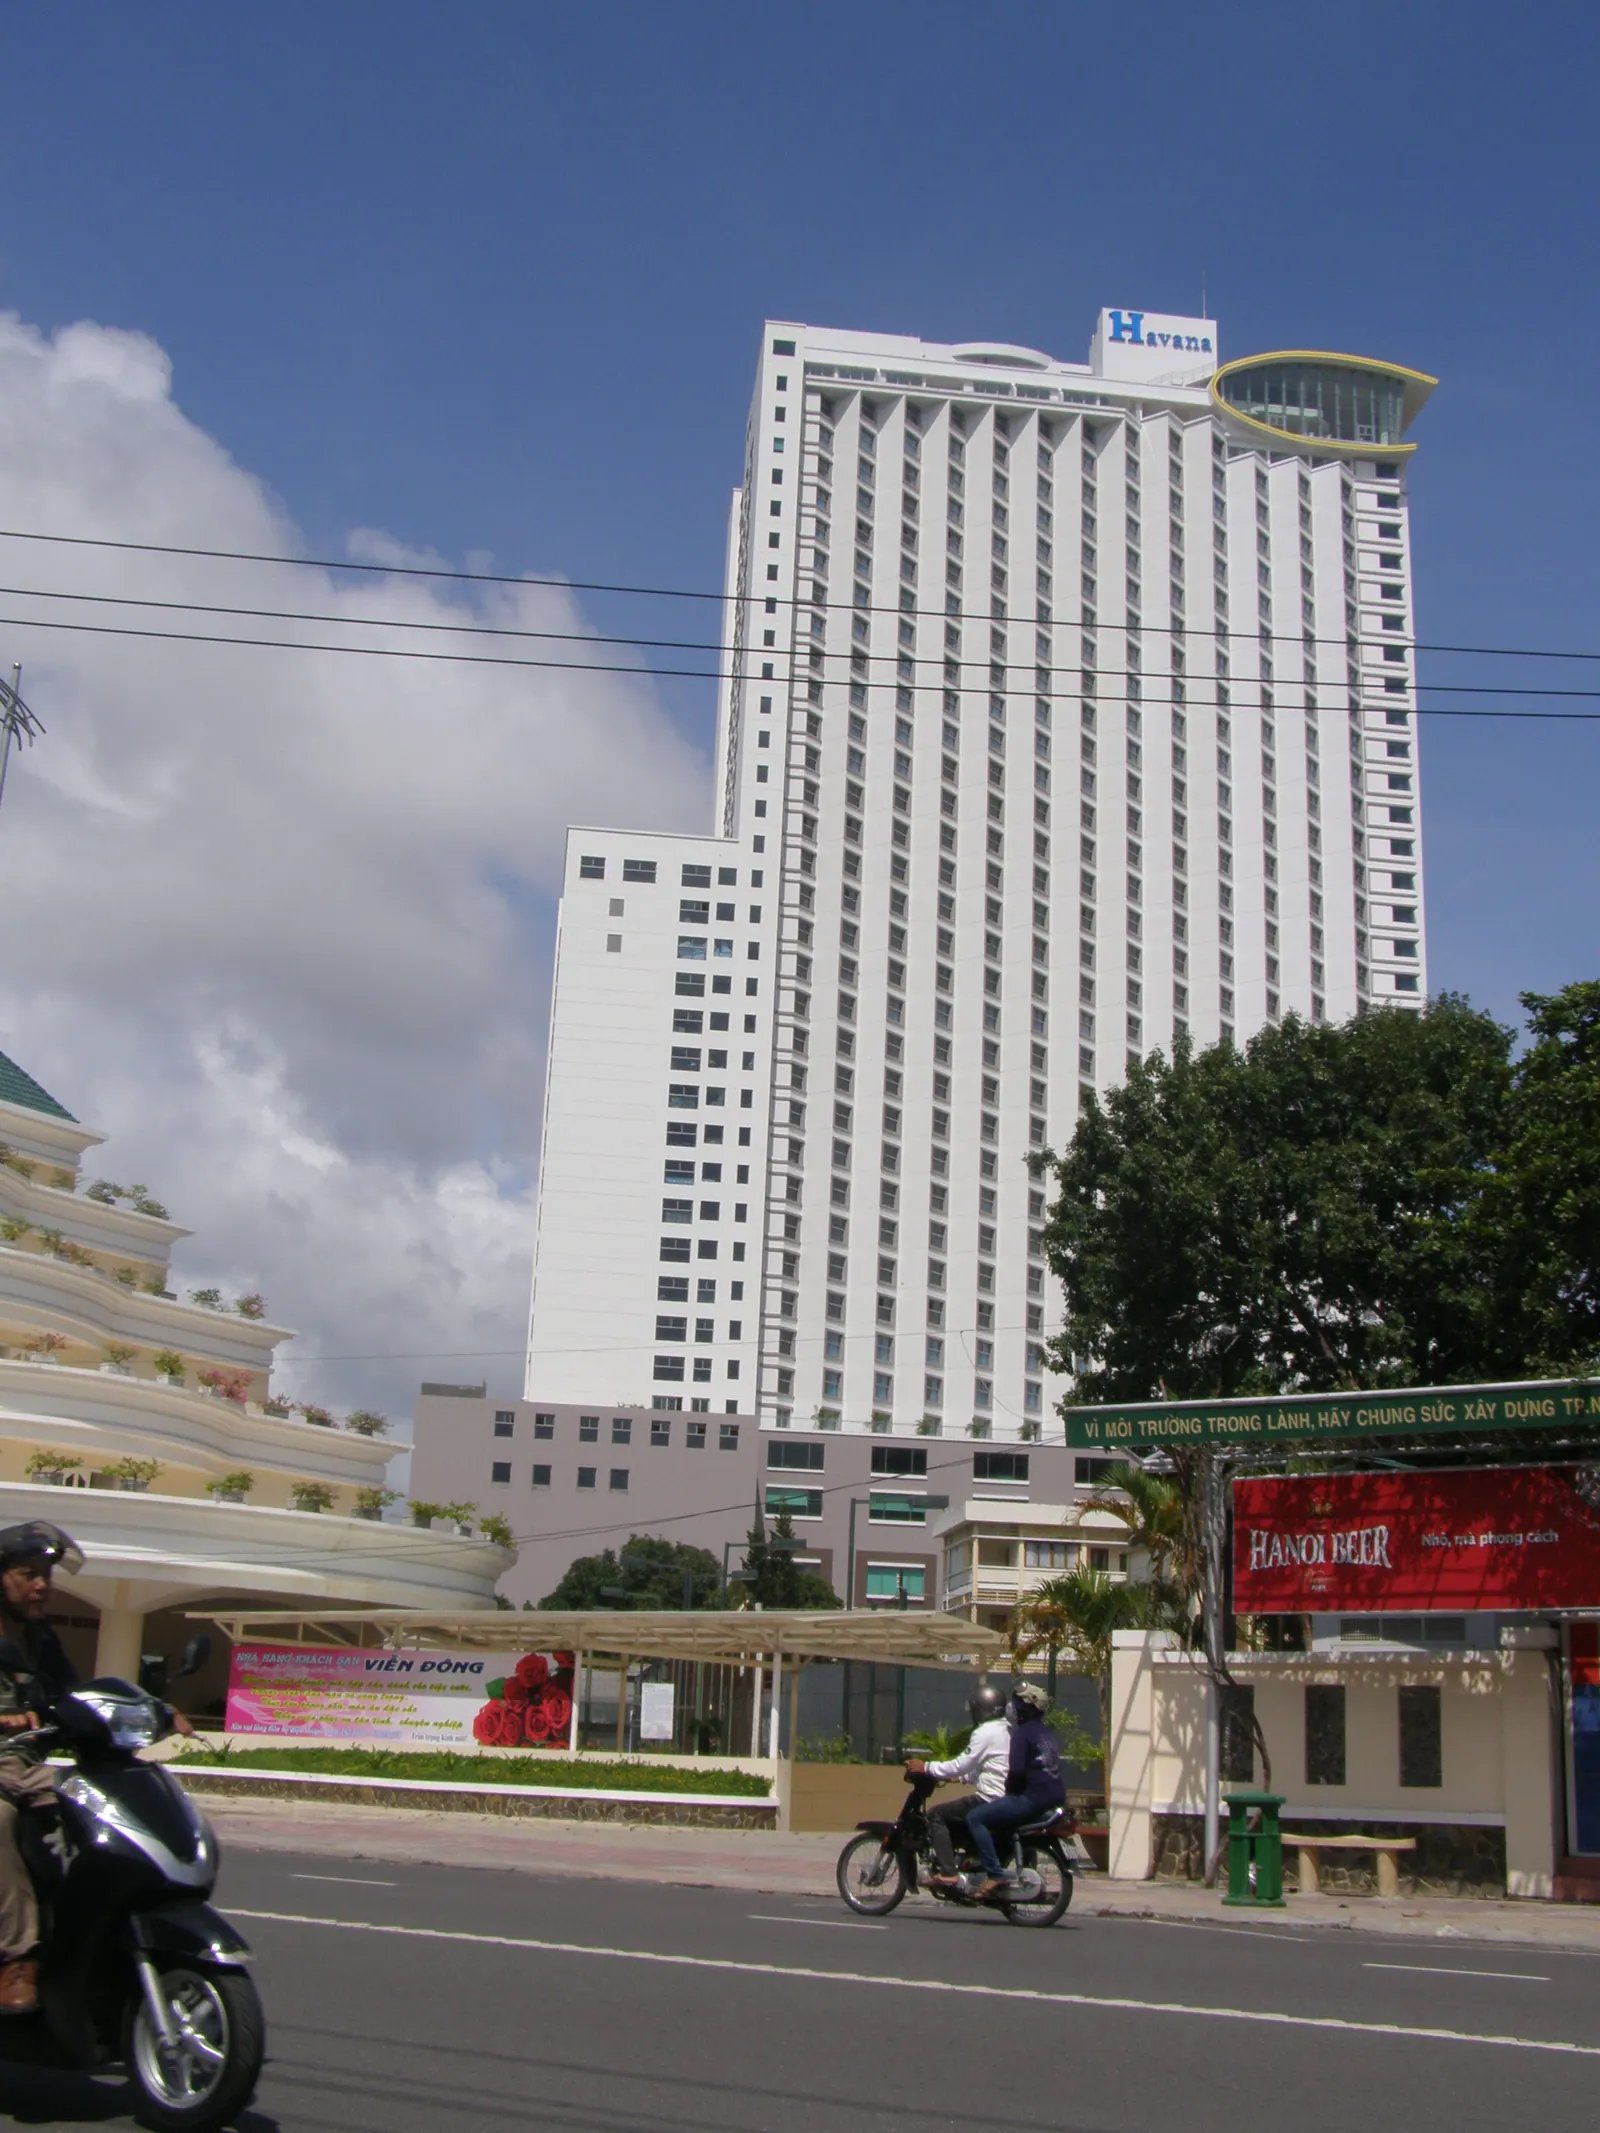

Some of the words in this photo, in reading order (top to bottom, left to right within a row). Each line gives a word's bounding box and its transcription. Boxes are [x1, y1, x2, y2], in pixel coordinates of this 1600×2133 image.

[1108, 310, 1213, 354] Havana
[1085, 1418, 1099, 1438] VÌ
[1105, 1417, 1133, 1438] MÔI
[1137, 1414, 1202, 1436] TRƯỜNG
[1207, 1414, 1262, 1433] TRONG
[1267, 1409, 1315, 1431] LÀNH,
[1318, 1407, 1351, 1428] HÃY
[1356, 1407, 1416, 1426] CHUNG
[1421, 1400, 1456, 1422] SỨC
[1464, 1399, 1497, 1420] XÂY
[1504, 1398, 1556, 1422] DỰNG
[1249, 1528, 1326, 1571] HANOI
[1330, 1524, 1393, 1569] BEER
[1479, 1530, 1524, 1548] phong
[1526, 1528, 1560, 1544] cách
[364, 1654, 414, 1672] VIỄN
[419, 1658, 485, 1674] ĐÔNG
